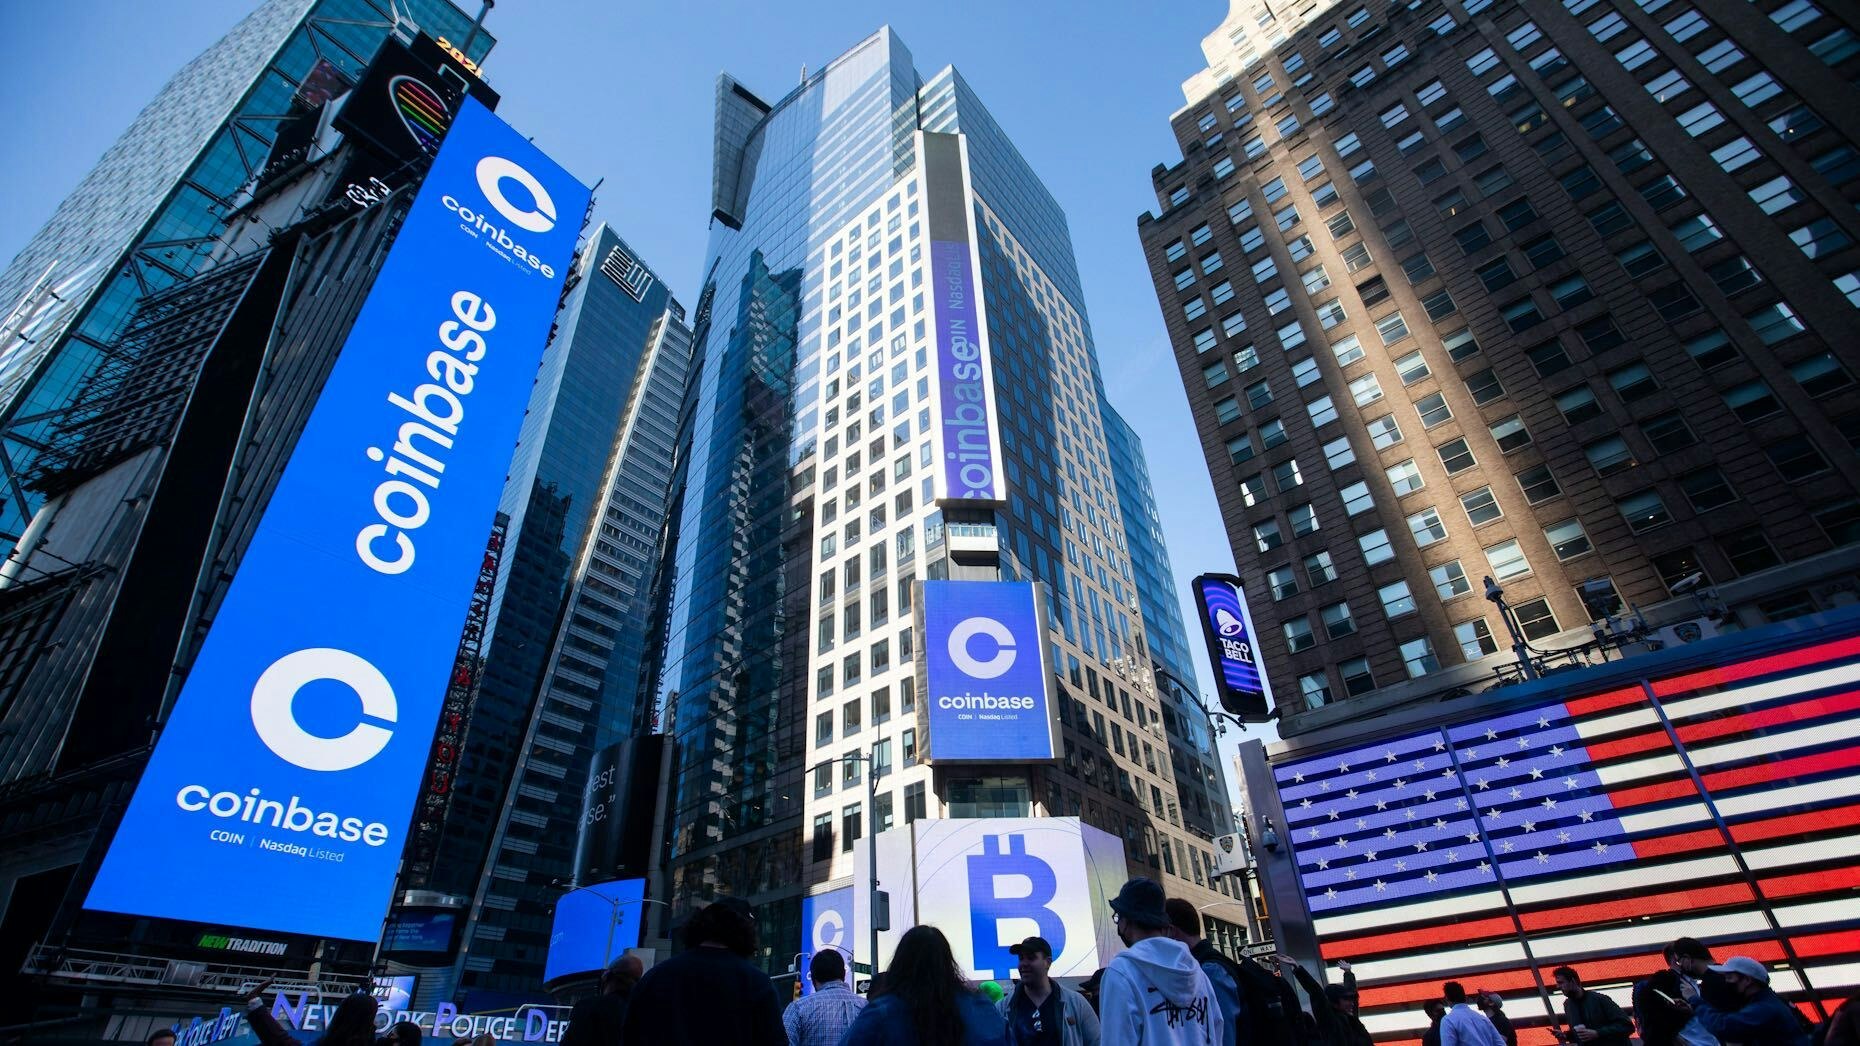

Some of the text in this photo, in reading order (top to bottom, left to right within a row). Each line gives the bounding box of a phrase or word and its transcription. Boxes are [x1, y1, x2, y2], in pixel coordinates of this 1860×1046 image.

[442, 195, 555, 279] coinbase
[356, 290, 497, 575] coinbase
[1219, 637, 1250, 654] TACO
[1224, 648, 1253, 664] BELL
[938, 692, 1035, 710] coinbase
[979, 713, 1001, 721] Nasdaq
[176, 784, 389, 847] coinbase
[210, 829, 345, 863] COIN Nasdaq Listed
[1243, 947, 1256, 956] ONE
[210, 1006, 241, 1043] DEPT
[432, 1001, 516, 1040] POLICE
